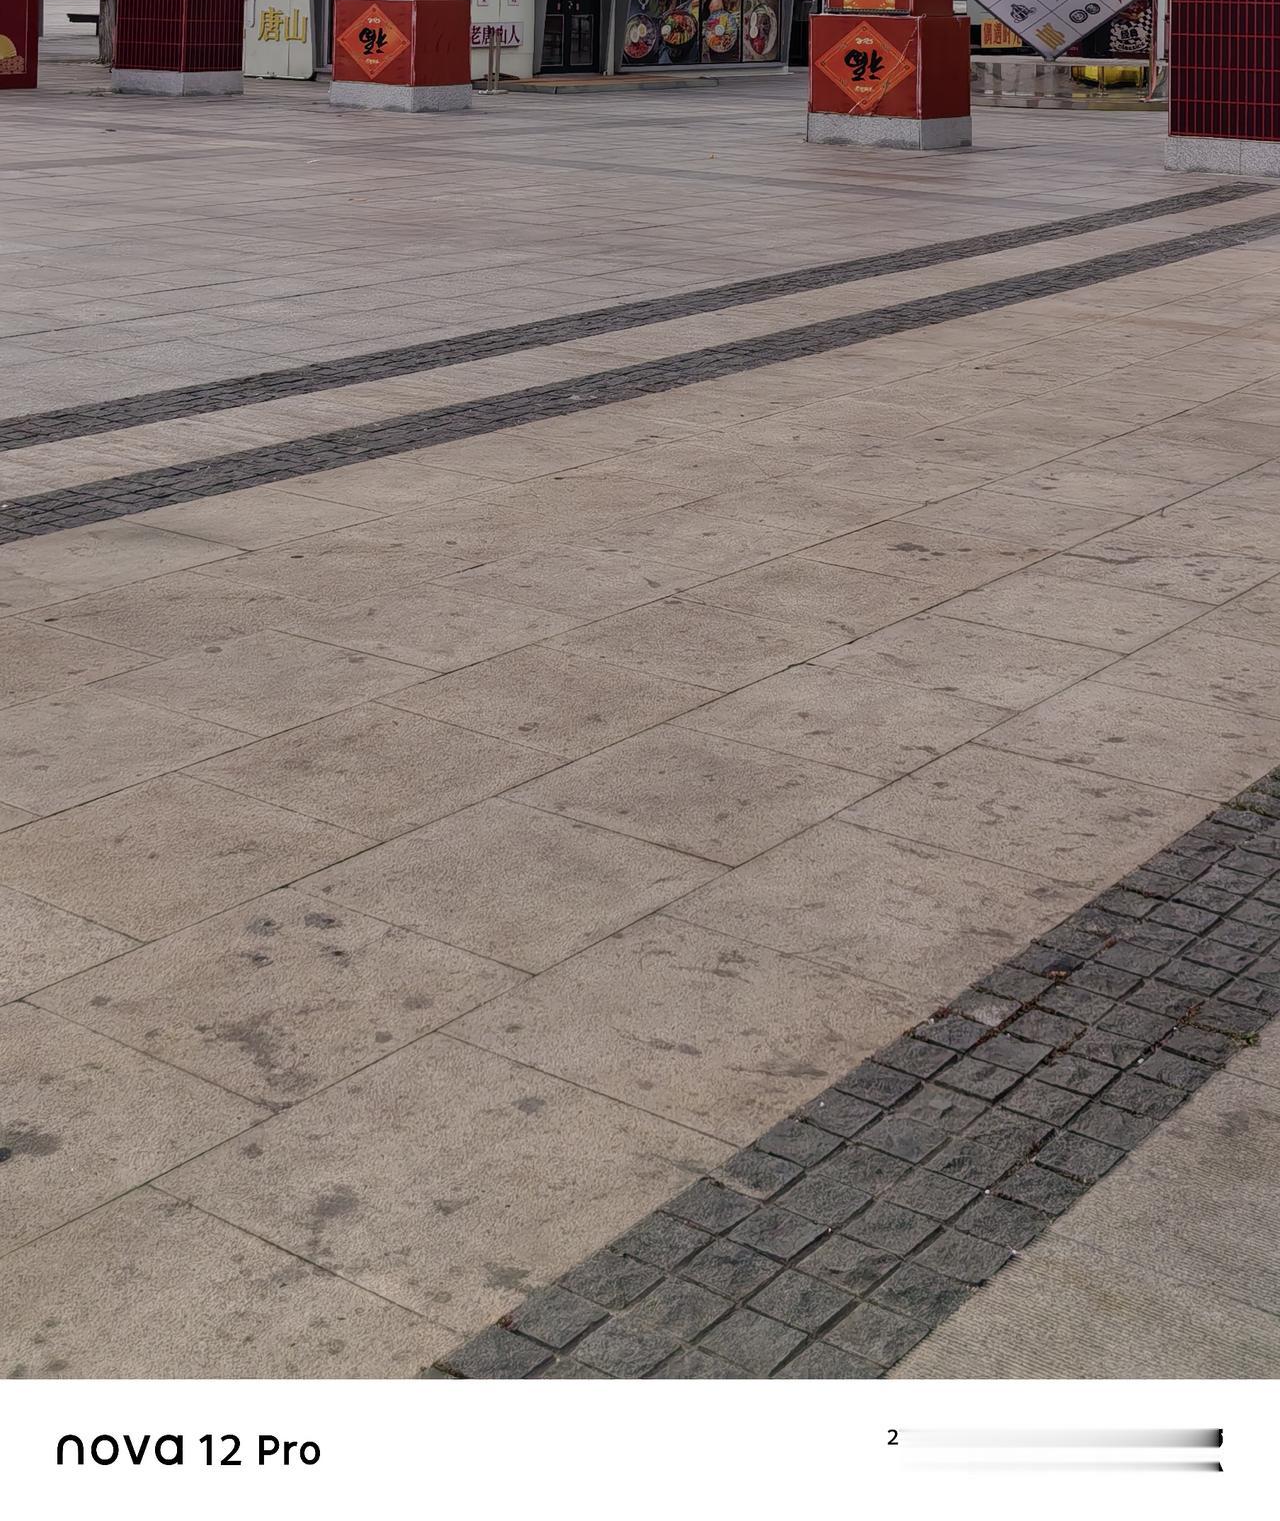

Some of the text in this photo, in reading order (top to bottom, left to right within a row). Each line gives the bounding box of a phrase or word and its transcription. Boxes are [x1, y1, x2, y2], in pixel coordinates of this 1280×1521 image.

[257, 6, 308, 43] 唐山
[358, 27, 388, 56] 福
[843, 48, 885, 82] 福
